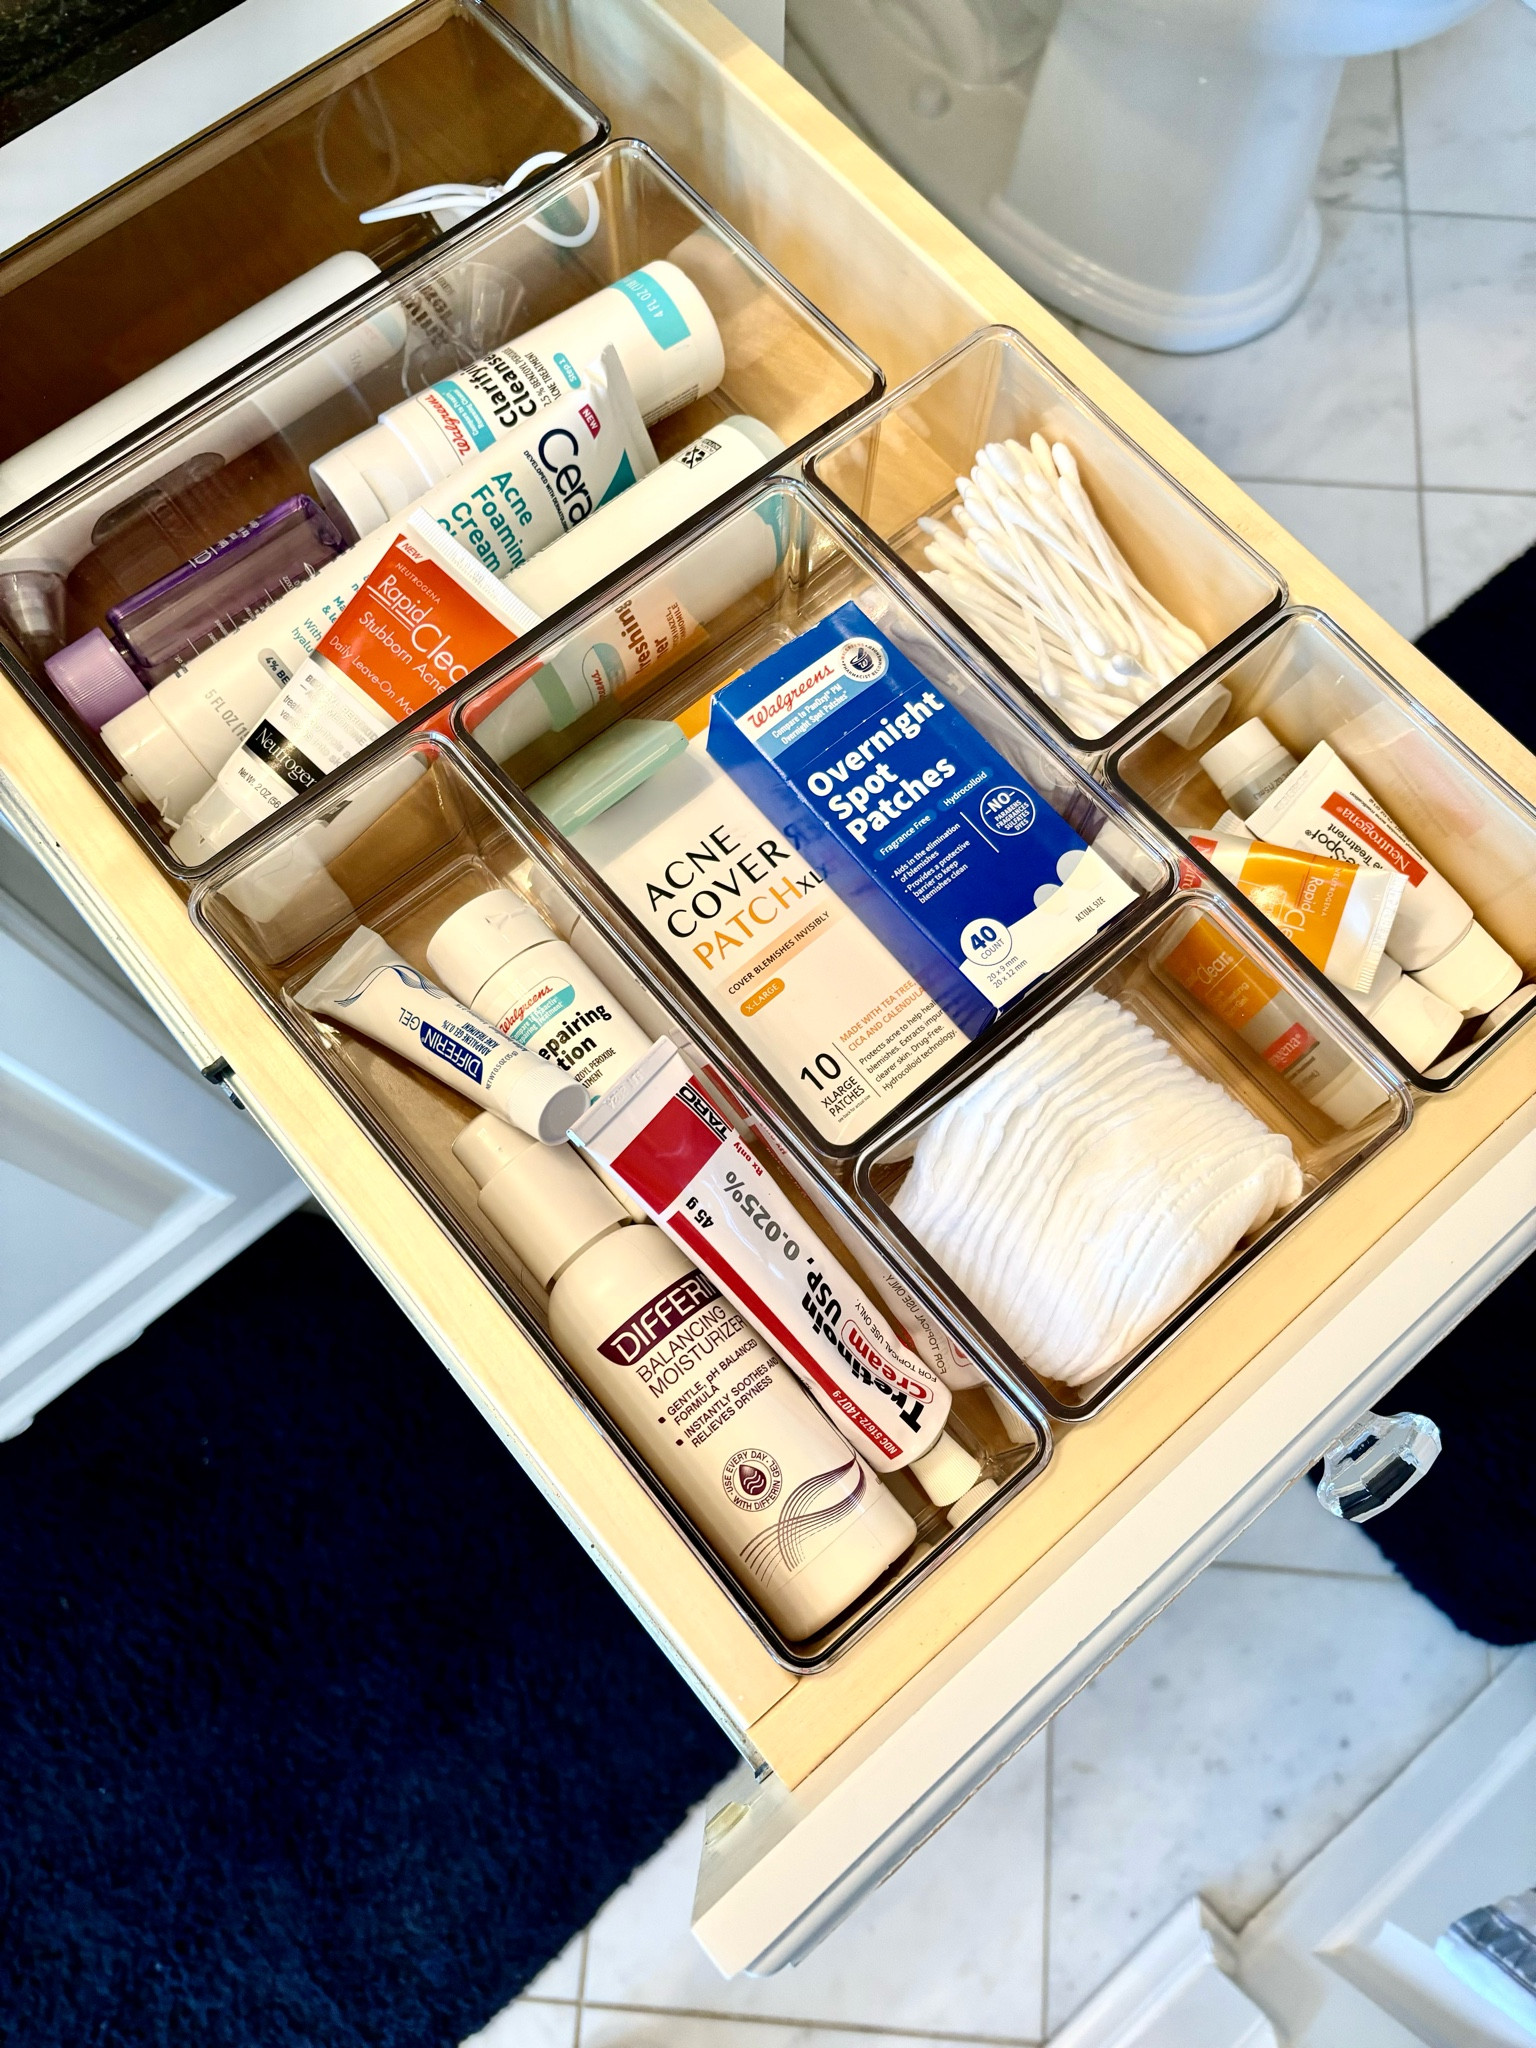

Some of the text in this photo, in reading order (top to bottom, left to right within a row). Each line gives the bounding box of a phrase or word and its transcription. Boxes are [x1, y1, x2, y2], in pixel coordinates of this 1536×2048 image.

[636, 287, 665, 319] 4 FL OZ
[481, 353, 537, 418] Cleanse
[518, 361, 541, 388] BENZOYL
[525, 350, 553, 383] TREATMENT
[561, 360, 577, 382] Step
[462, 361, 518, 428] Clarifyi
[426, 395, 471, 456] Walgreens
[582, 409, 598, 430] NEW
[523, 450, 555, 498] DEVELOPED WITH
[538, 429, 592, 526] Cera
[491, 472, 533, 526] Acne
[402, 543, 423, 560] NEW
[451, 503, 500, 572] Cream
[395, 563, 440, 604] NEUTROGENA
[304, 618, 322, 641] With
[359, 611, 448, 694] Stubborn Acne
[411, 623, 469, 684] Clea
[615, 599, 651, 675] reshing
[265, 656, 279, 672] 4%
[329, 635, 396, 699] Daily Leave-On
[211, 696, 222, 713] FL
[222, 709, 239, 727] OZ
[748, 665, 834, 729] Walgreens
[772, 683, 843, 738] Compare to PM
[781, 710, 825, 745] Overnight Spot
[807, 691, 945, 797] Overnight
[255, 728, 318, 788] Neutroge
[238, 767, 248, 777] Net
[259, 788, 272, 800] OZ
[828, 762, 898, 820] Spot
[845, 758, 956, 845] Patches
[943, 771, 988, 807] Hydrocolloid
[994, 800, 1022, 821] PARABENS
[996, 802, 1029, 829] FRAGRANCES
[1004, 810, 1030, 830] SULFATES
[1014, 819, 1029, 831] DYES
[880, 815, 931, 856] Fragrance Free
[894, 823, 960, 878] Aids in the elimination
[1327, 823, 1373, 866] Treatment
[1341, 808, 1410, 872] Neutrogena
[646, 825, 741, 912] ACNE
[667, 840, 790, 938] COVER
[900, 851, 939, 883] of blemishes
[906, 867, 936, 892] Provides
[939, 840, 970, 867] protective
[912, 860, 959, 898] barrier to keep
[918, 864, 968, 904] blemishes clean
[1075, 896, 1106, 922] ACTUAL SIZE
[1302, 876, 1324, 914] Rapid
[1321, 867, 1344, 916] NEUTROGENA
[728, 911, 830, 995] COVER BLEMISHES INVISIBLY
[970, 925, 997, 951] 40
[980, 938, 1005, 960] COUNT
[987, 973, 996, 983] 20
[1004, 955, 1018, 968] mm
[993, 959, 1028, 988] 20 12 mm
[399, 1007, 420, 1031] GEL
[500, 985, 553, 1034] Walgreens
[745, 983, 780, 1013] X-LARGE
[840, 980, 916, 1042] MADE WITH TEA TREE,
[848, 986, 925, 1051] CICA AND CALENDULA
[424, 1028, 481, 1078] DIFFERIN
[453, 1026, 464, 1038] GEL
[460, 1020, 488, 1042] TREATMENT
[460, 1032, 492, 1057] ADAPALENE
[483, 1035, 500, 1050] ACNE
[538, 1005, 612, 1060] epairing
[557, 1037, 598, 1071] tion
[859, 1012, 923, 1065] Protects acne to help
[866, 1024, 926, 1074] blemishes. Extracts
[875, 1024, 945, 1083] clearer skin. Drug-Free.
[590, 1047, 616, 1070] PEROXIDE
[800, 1053, 841, 1091] 10
[882, 1030, 958, 1092] Hydrocolloid technology.
[679, 1085, 730, 1139] TARO
[821, 1076, 858, 1109] XLARGE
[829, 1085, 865, 1117] PATCHES
[733, 1141, 763, 1177] Rx only
[685, 1196, 715, 1229] 45 g
[724, 1171, 800, 1261] 0.025%
[636, 1305, 726, 1383] BALANCING
[648, 1314, 749, 1399] MOISTURIZER
[801, 1292, 925, 1434] Tretinoin
[848, 1326, 928, 1400] Cream
[870, 1326, 937, 1383] FOR TOPICAL USE
[667, 1338, 758, 1416] GENTLE, pH BALANCED
[684, 1356, 779, 1438] INSTANTLY SOOTHES AND
[673, 1385, 720, 1426] FORMULA
[691, 1375, 773, 1448] RELIEVES DRYNESS
[833, 1390, 898, 1455] NDC 51672-1407-9
[725, 1451, 767, 1492] USE EVERY DAY
[734, 1460, 780, 1510] WITH DIFFERIN GEL
